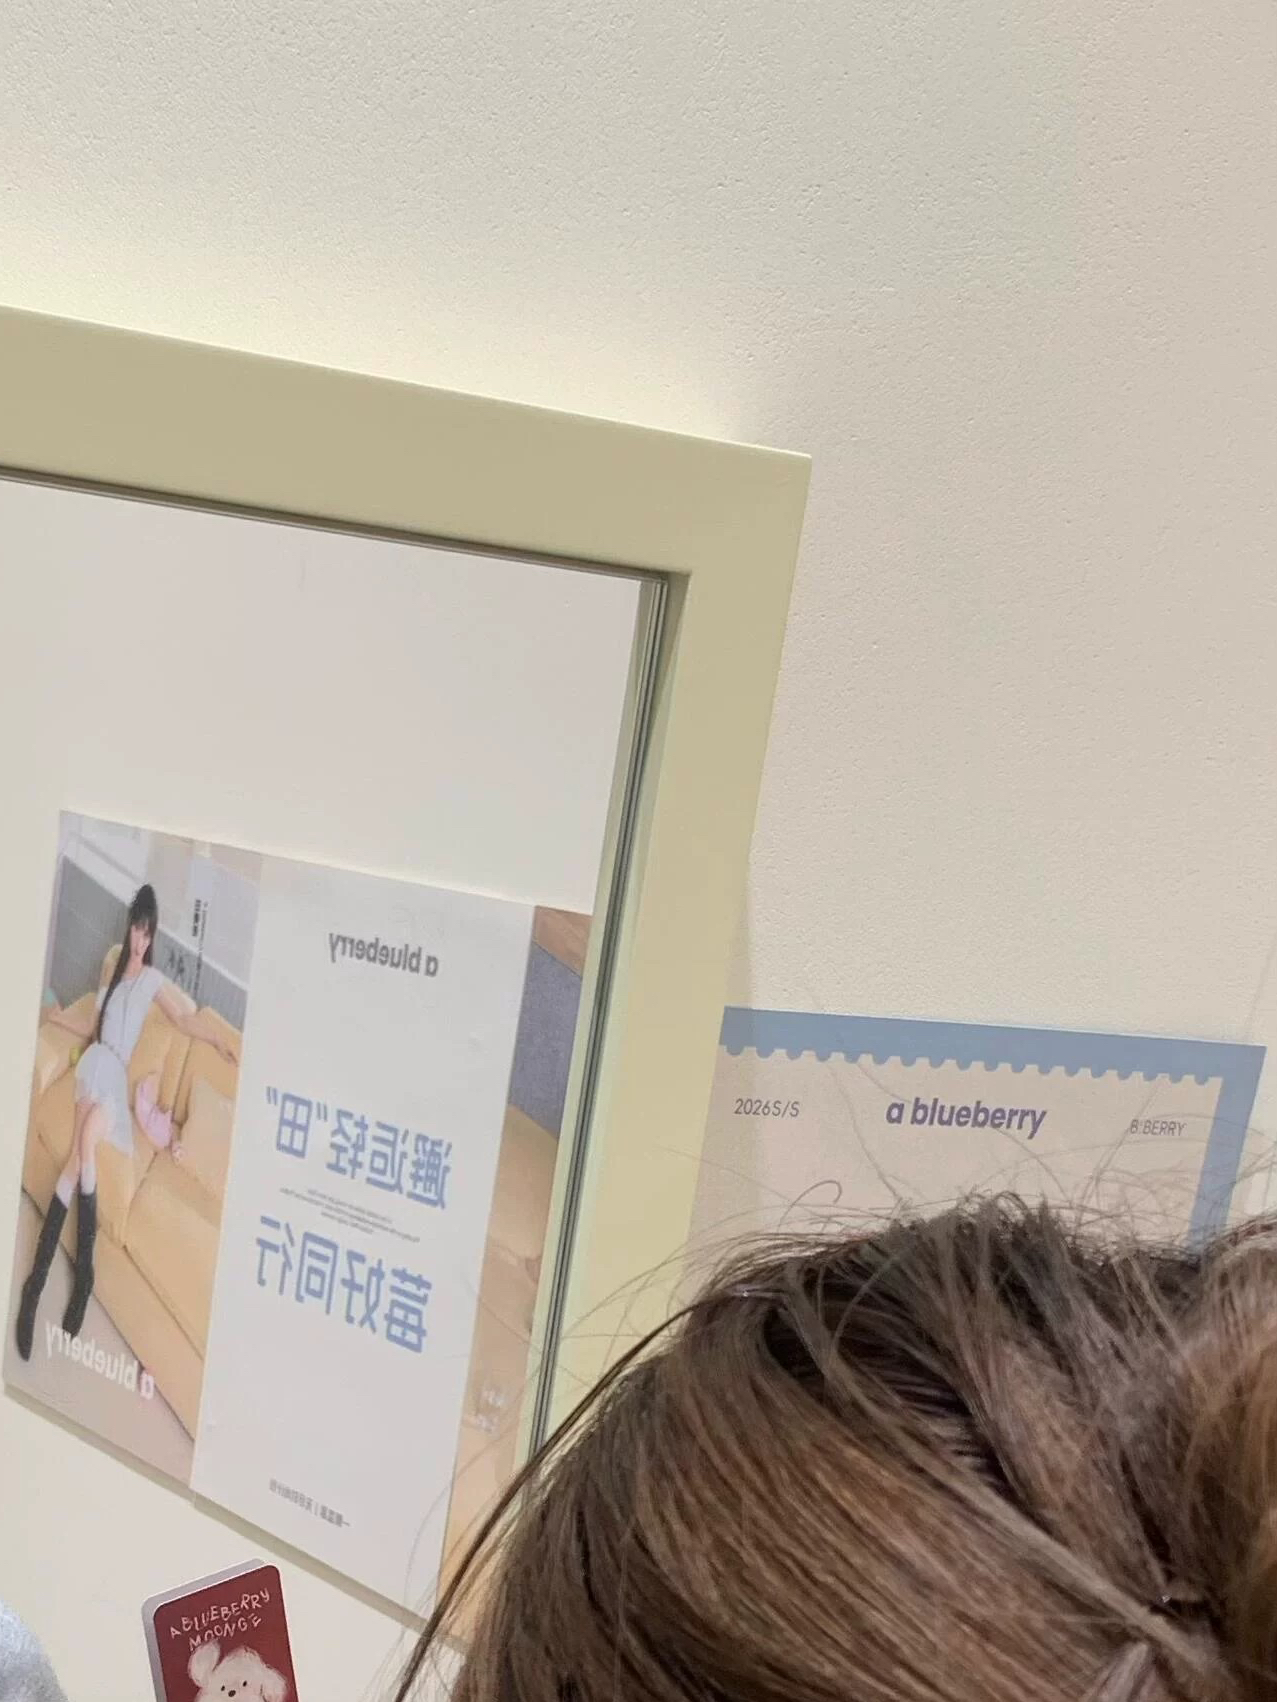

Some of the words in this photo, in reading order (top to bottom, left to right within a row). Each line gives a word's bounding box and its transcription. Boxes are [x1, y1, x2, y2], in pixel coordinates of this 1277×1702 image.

[886, 1101, 905, 1124] a
[910, 1097, 1047, 1139] blueberry
[170, 1626, 182, 1639] A
